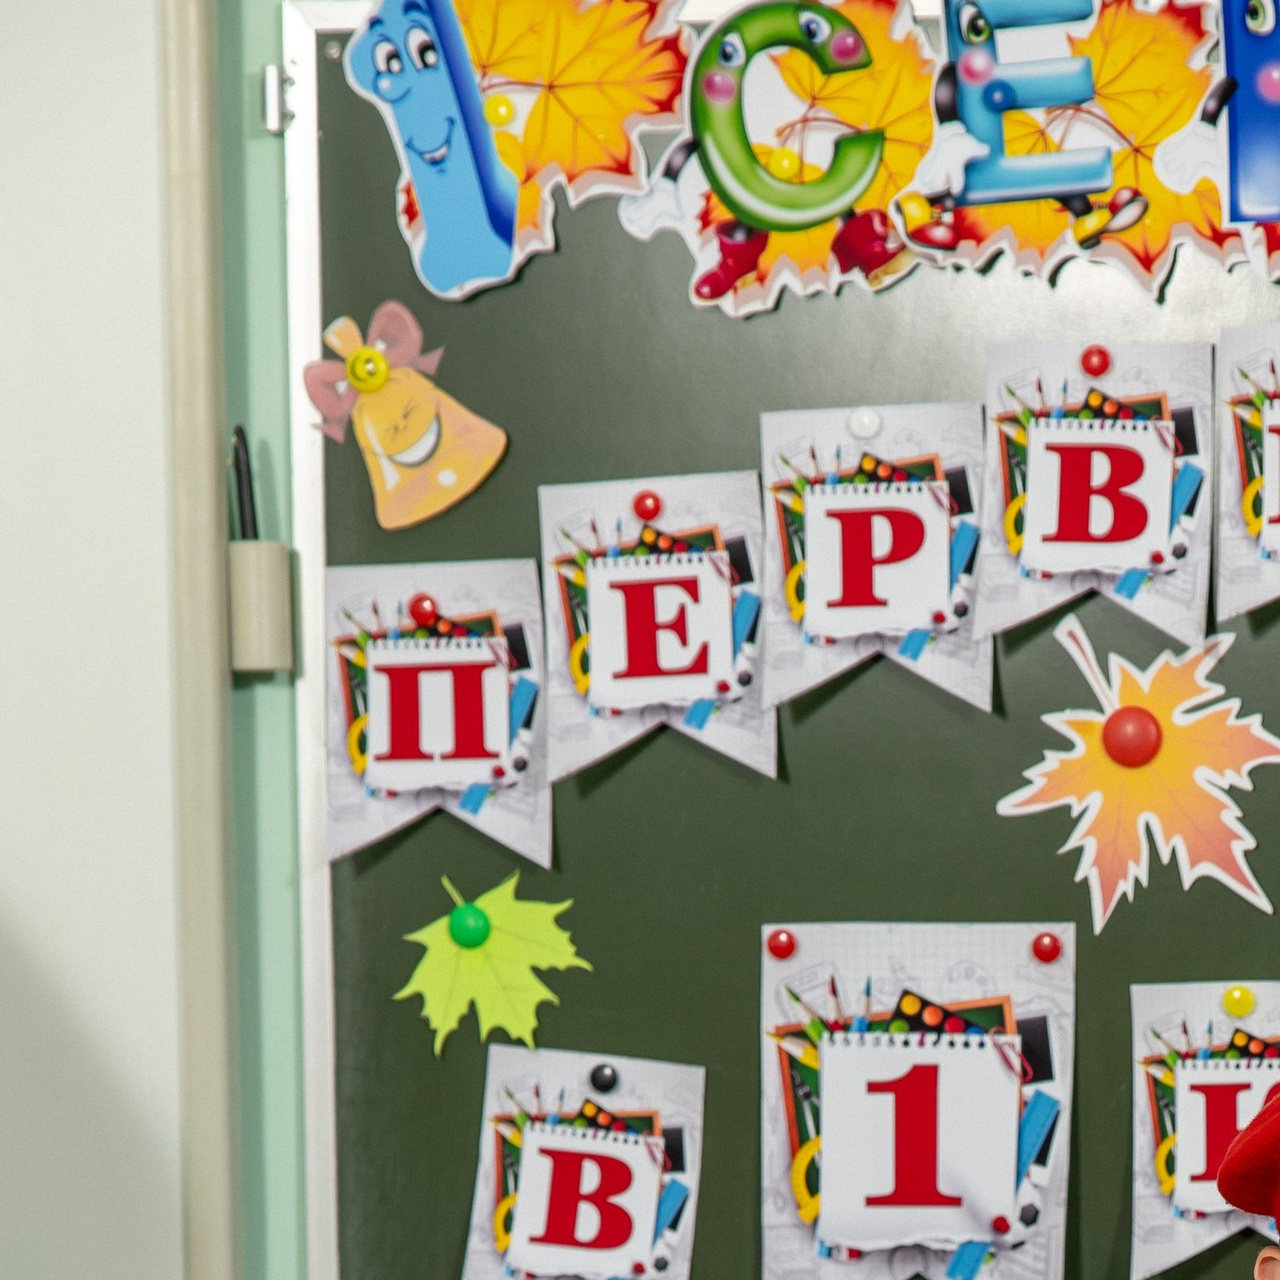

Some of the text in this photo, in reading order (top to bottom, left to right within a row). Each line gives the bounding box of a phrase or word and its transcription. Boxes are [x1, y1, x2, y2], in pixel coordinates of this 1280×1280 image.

[347, 0, 520, 292] 1
[529, 1147, 634, 1250] В
[865, 1063, 964, 1208] 1
